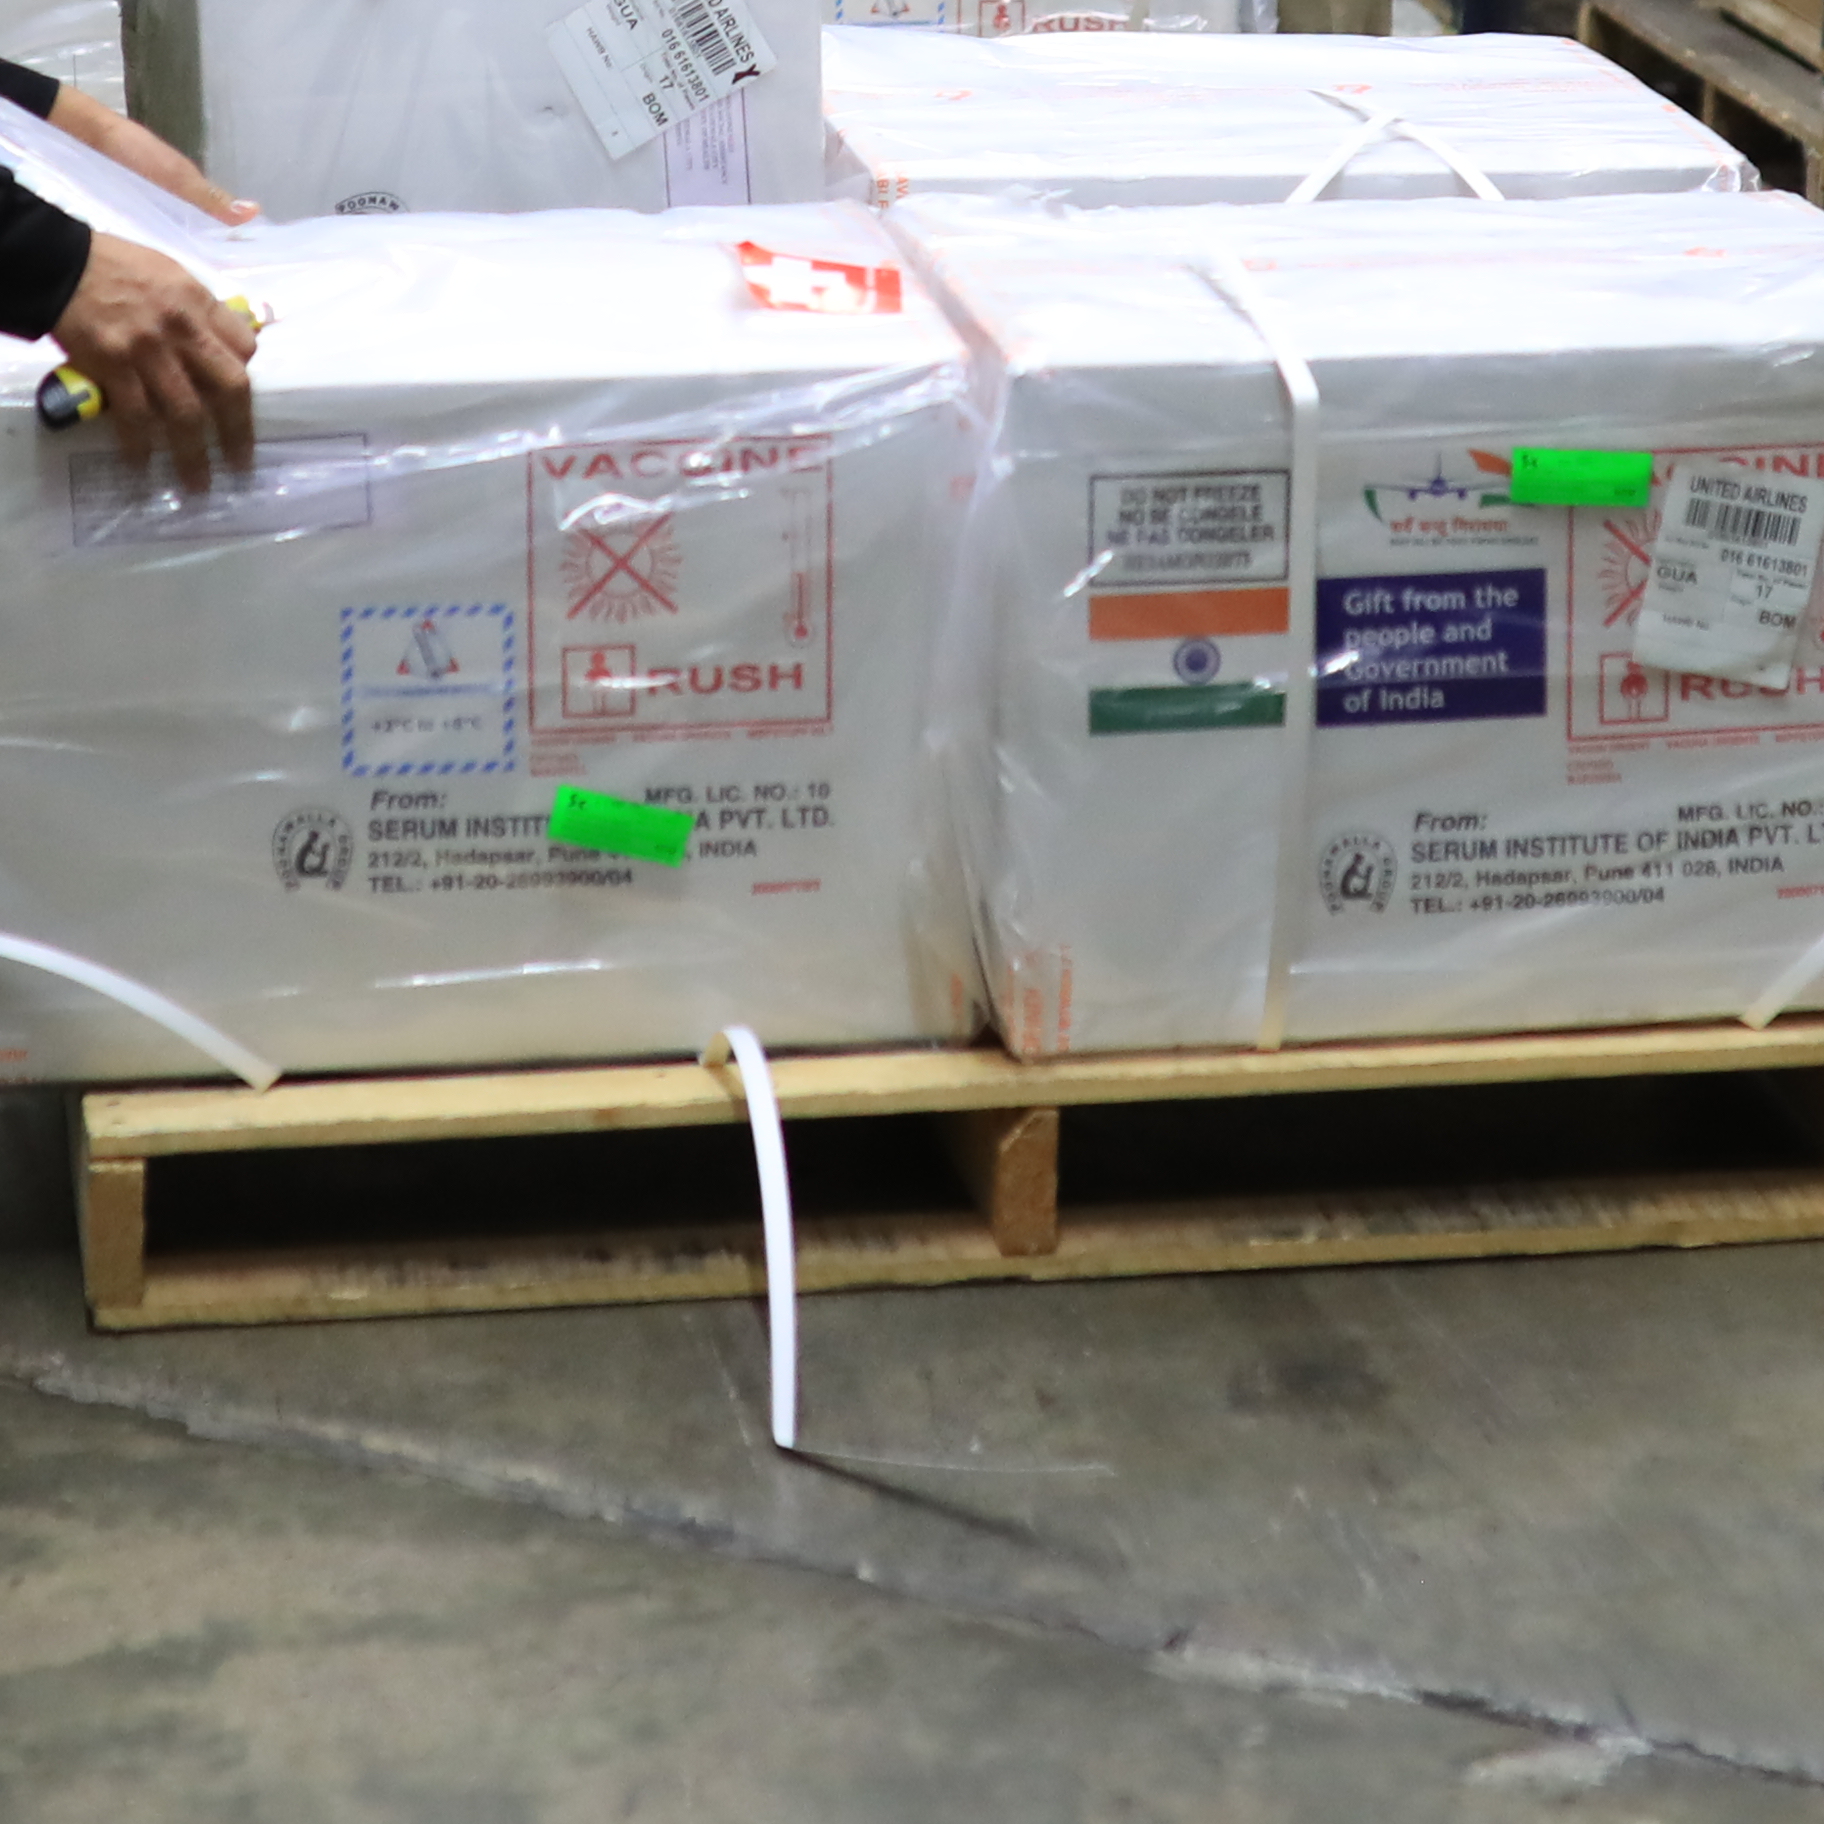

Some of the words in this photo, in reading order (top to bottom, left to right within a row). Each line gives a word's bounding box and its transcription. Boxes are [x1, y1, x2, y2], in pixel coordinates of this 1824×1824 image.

[713, 5, 756, 63] AIRLINES
[659, 27, 681, 51] 016
[672, 49, 711, 103] 61613801
[657, 74, 673, 91] 17
[641, 92, 668, 127] BOM
[1689, 475, 1741, 500] UNITED
[1744, 485, 1809, 514] AIRLINES
[1656, 565, 1699, 586] GUA
[1342, 588, 1396, 616] Gift
[1401, 584, 1467, 612] from
[1474, 582, 1520, 608] the
[1756, 584, 1774, 599] 17
[1758, 609, 1798, 630] BOM
[1342, 620, 1436, 653] people
[1442, 618, 1493, 644] and
[647, 662, 804, 696] RUSH
[1342, 651, 1509, 679] Government
[1342, 685, 1371, 713] of
[1379, 682, 1446, 710] India
[370, 789, 448, 812] From:
[644, 785, 699, 806] MFG.
[706, 784, 745, 804] LIC.
[366, 817, 458, 842] SERUM
[465, 815, 551, 839] INSTIT
[719, 809, 775, 832] PVT.
[781, 805, 836, 829] LTD.
[1413, 810, 1488, 833] From:
[1678, 802, 1729, 823] MFG.
[1735, 800, 1776, 822] LIC.
[698, 839, 759, 859] INDIA
[1410, 838, 1500, 864] SERUM
[1505, 833, 1630, 860] INSTITUTE
[1636, 831, 1671, 854] OF
[1677, 827, 1740, 852] INDIA
[1746, 823, 1802, 849] PVT.
[1410, 869, 1470, 891] 212/2,
[1475, 864, 1579, 889] Hadapsar,
[1584, 862, 1636, 883] Pune
[1728, 855, 1786, 876] INDIA
